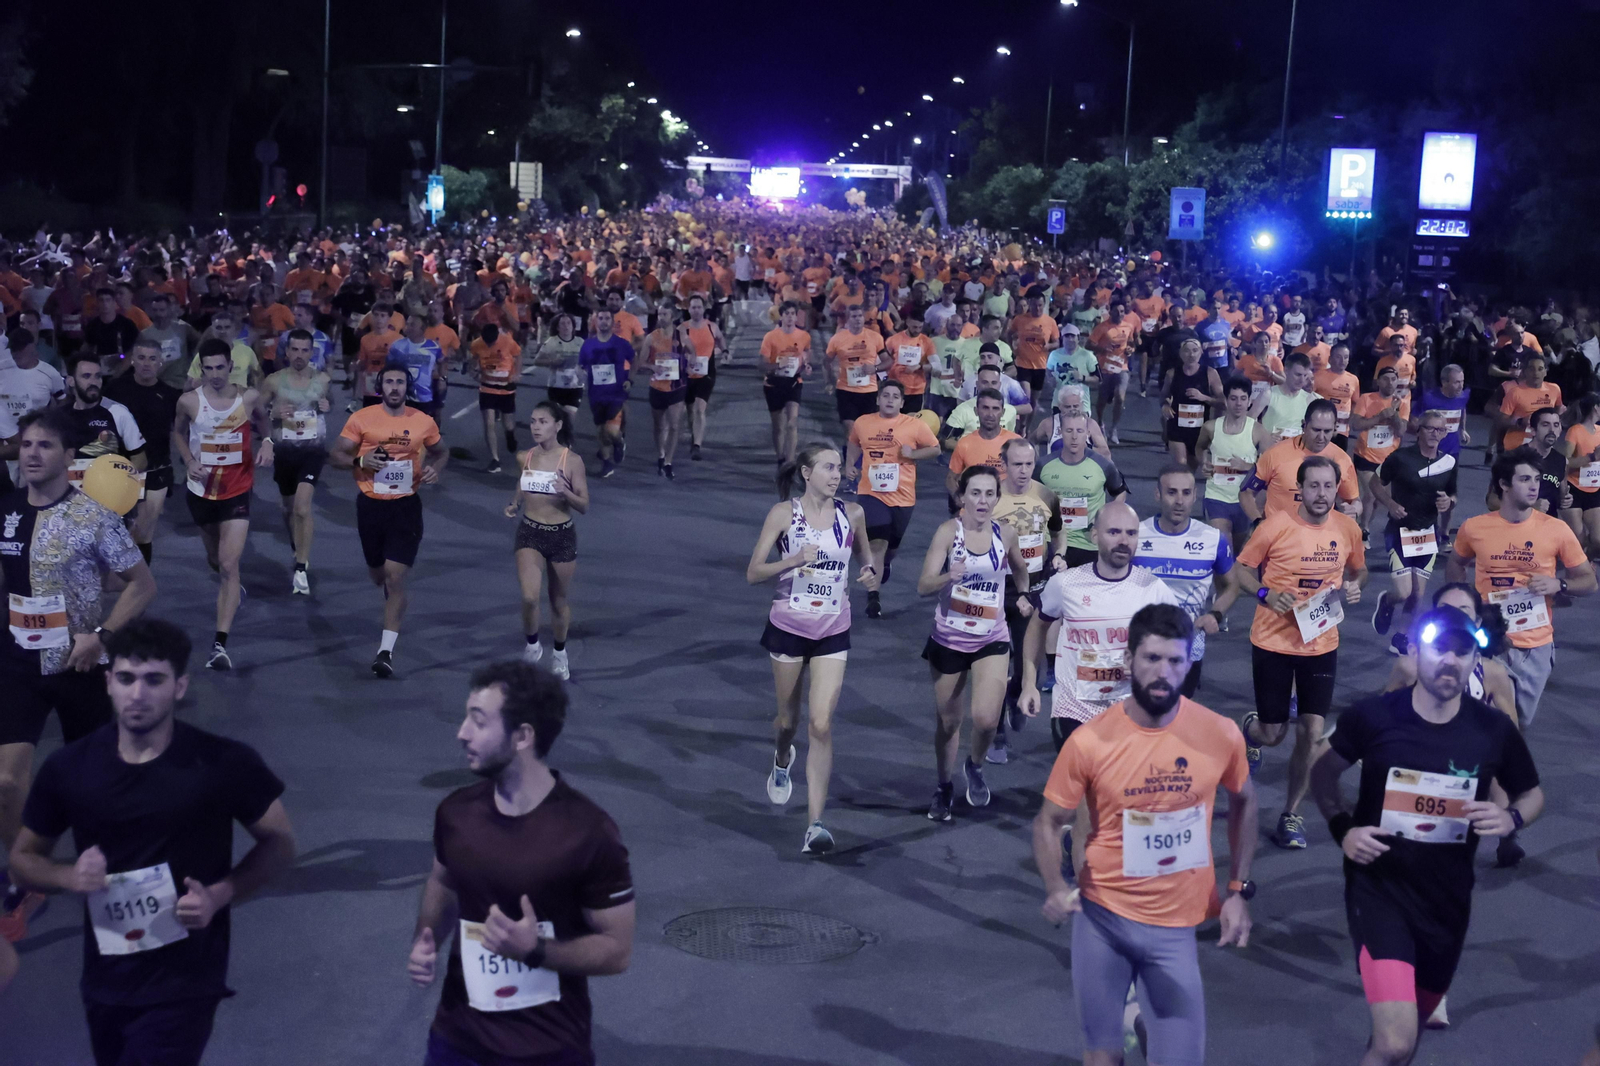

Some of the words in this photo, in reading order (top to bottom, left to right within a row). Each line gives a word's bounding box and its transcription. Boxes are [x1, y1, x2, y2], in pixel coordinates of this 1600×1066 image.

[1340, 153, 1367, 190] P
[1051, 211, 1061, 223] P
[1419, 219, 1467, 234] 22:02
[296, 420, 305, 429] 95
[214, 443, 231, 453] 748
[114, 462, 134, 472] KH7
[385, 471, 404, 481] 4389
[528, 481, 550, 492] 15998
[1062, 508, 1077, 516] 934
[538, 524, 559, 532] PRO
[1183, 541, 1204, 551] ACS
[1410, 535, 1426, 545] 1017
[807, 582, 833, 596] 5303
[965, 604, 984, 617] 830
[1309, 602, 1331, 621] 6293
[1506, 601, 1533, 616] 6294
[24, 615, 47, 628] 819
[1093, 668, 1121, 681] 1178
[1145, 775, 1193, 785] NOCTURNA
[1124, 785, 1166, 797] SEVILLA
[1167, 783, 1192, 794] KH7
[1414, 796, 1446, 817] 695
[1142, 829, 1192, 851] 15019
[104, 895, 161, 922] 15119
[478, 953, 536, 975] 1511
